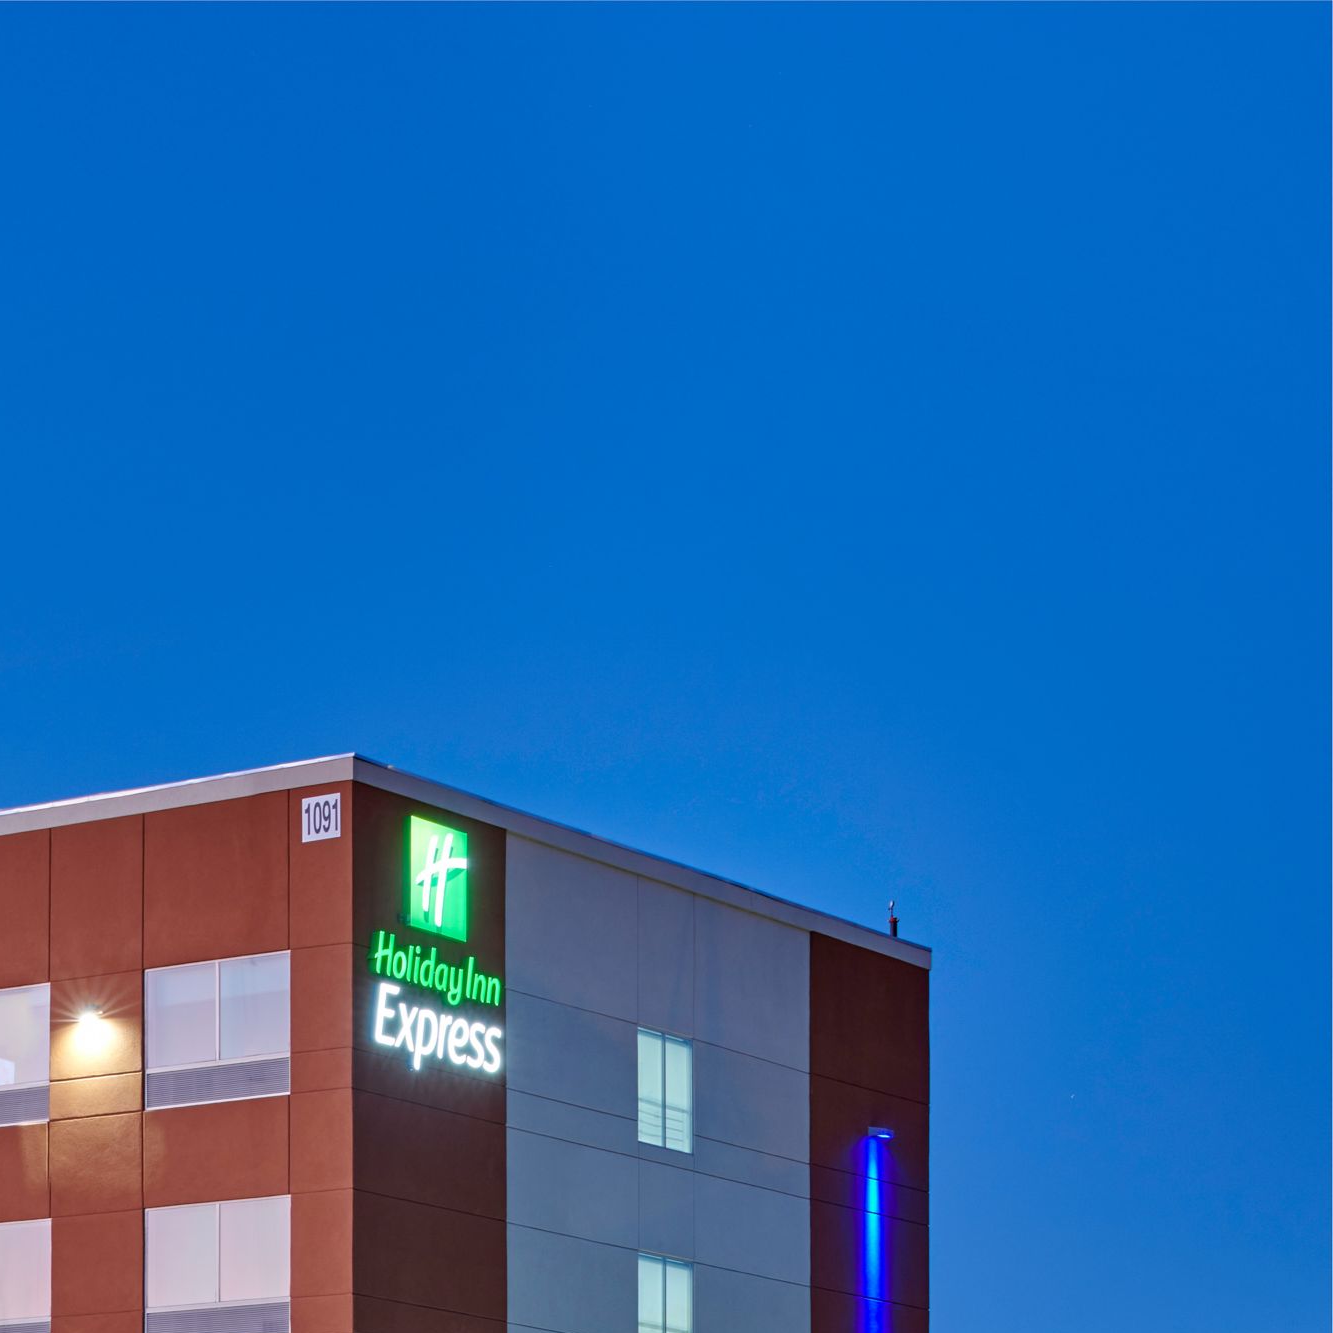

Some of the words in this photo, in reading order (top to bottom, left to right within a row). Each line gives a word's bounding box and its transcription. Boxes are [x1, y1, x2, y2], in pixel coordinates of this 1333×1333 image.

[305, 799, 339, 835] 1091
[374, 930, 464, 1006] Holiday
[465, 956, 501, 1006] Inn
[375, 983, 501, 1072] Express
